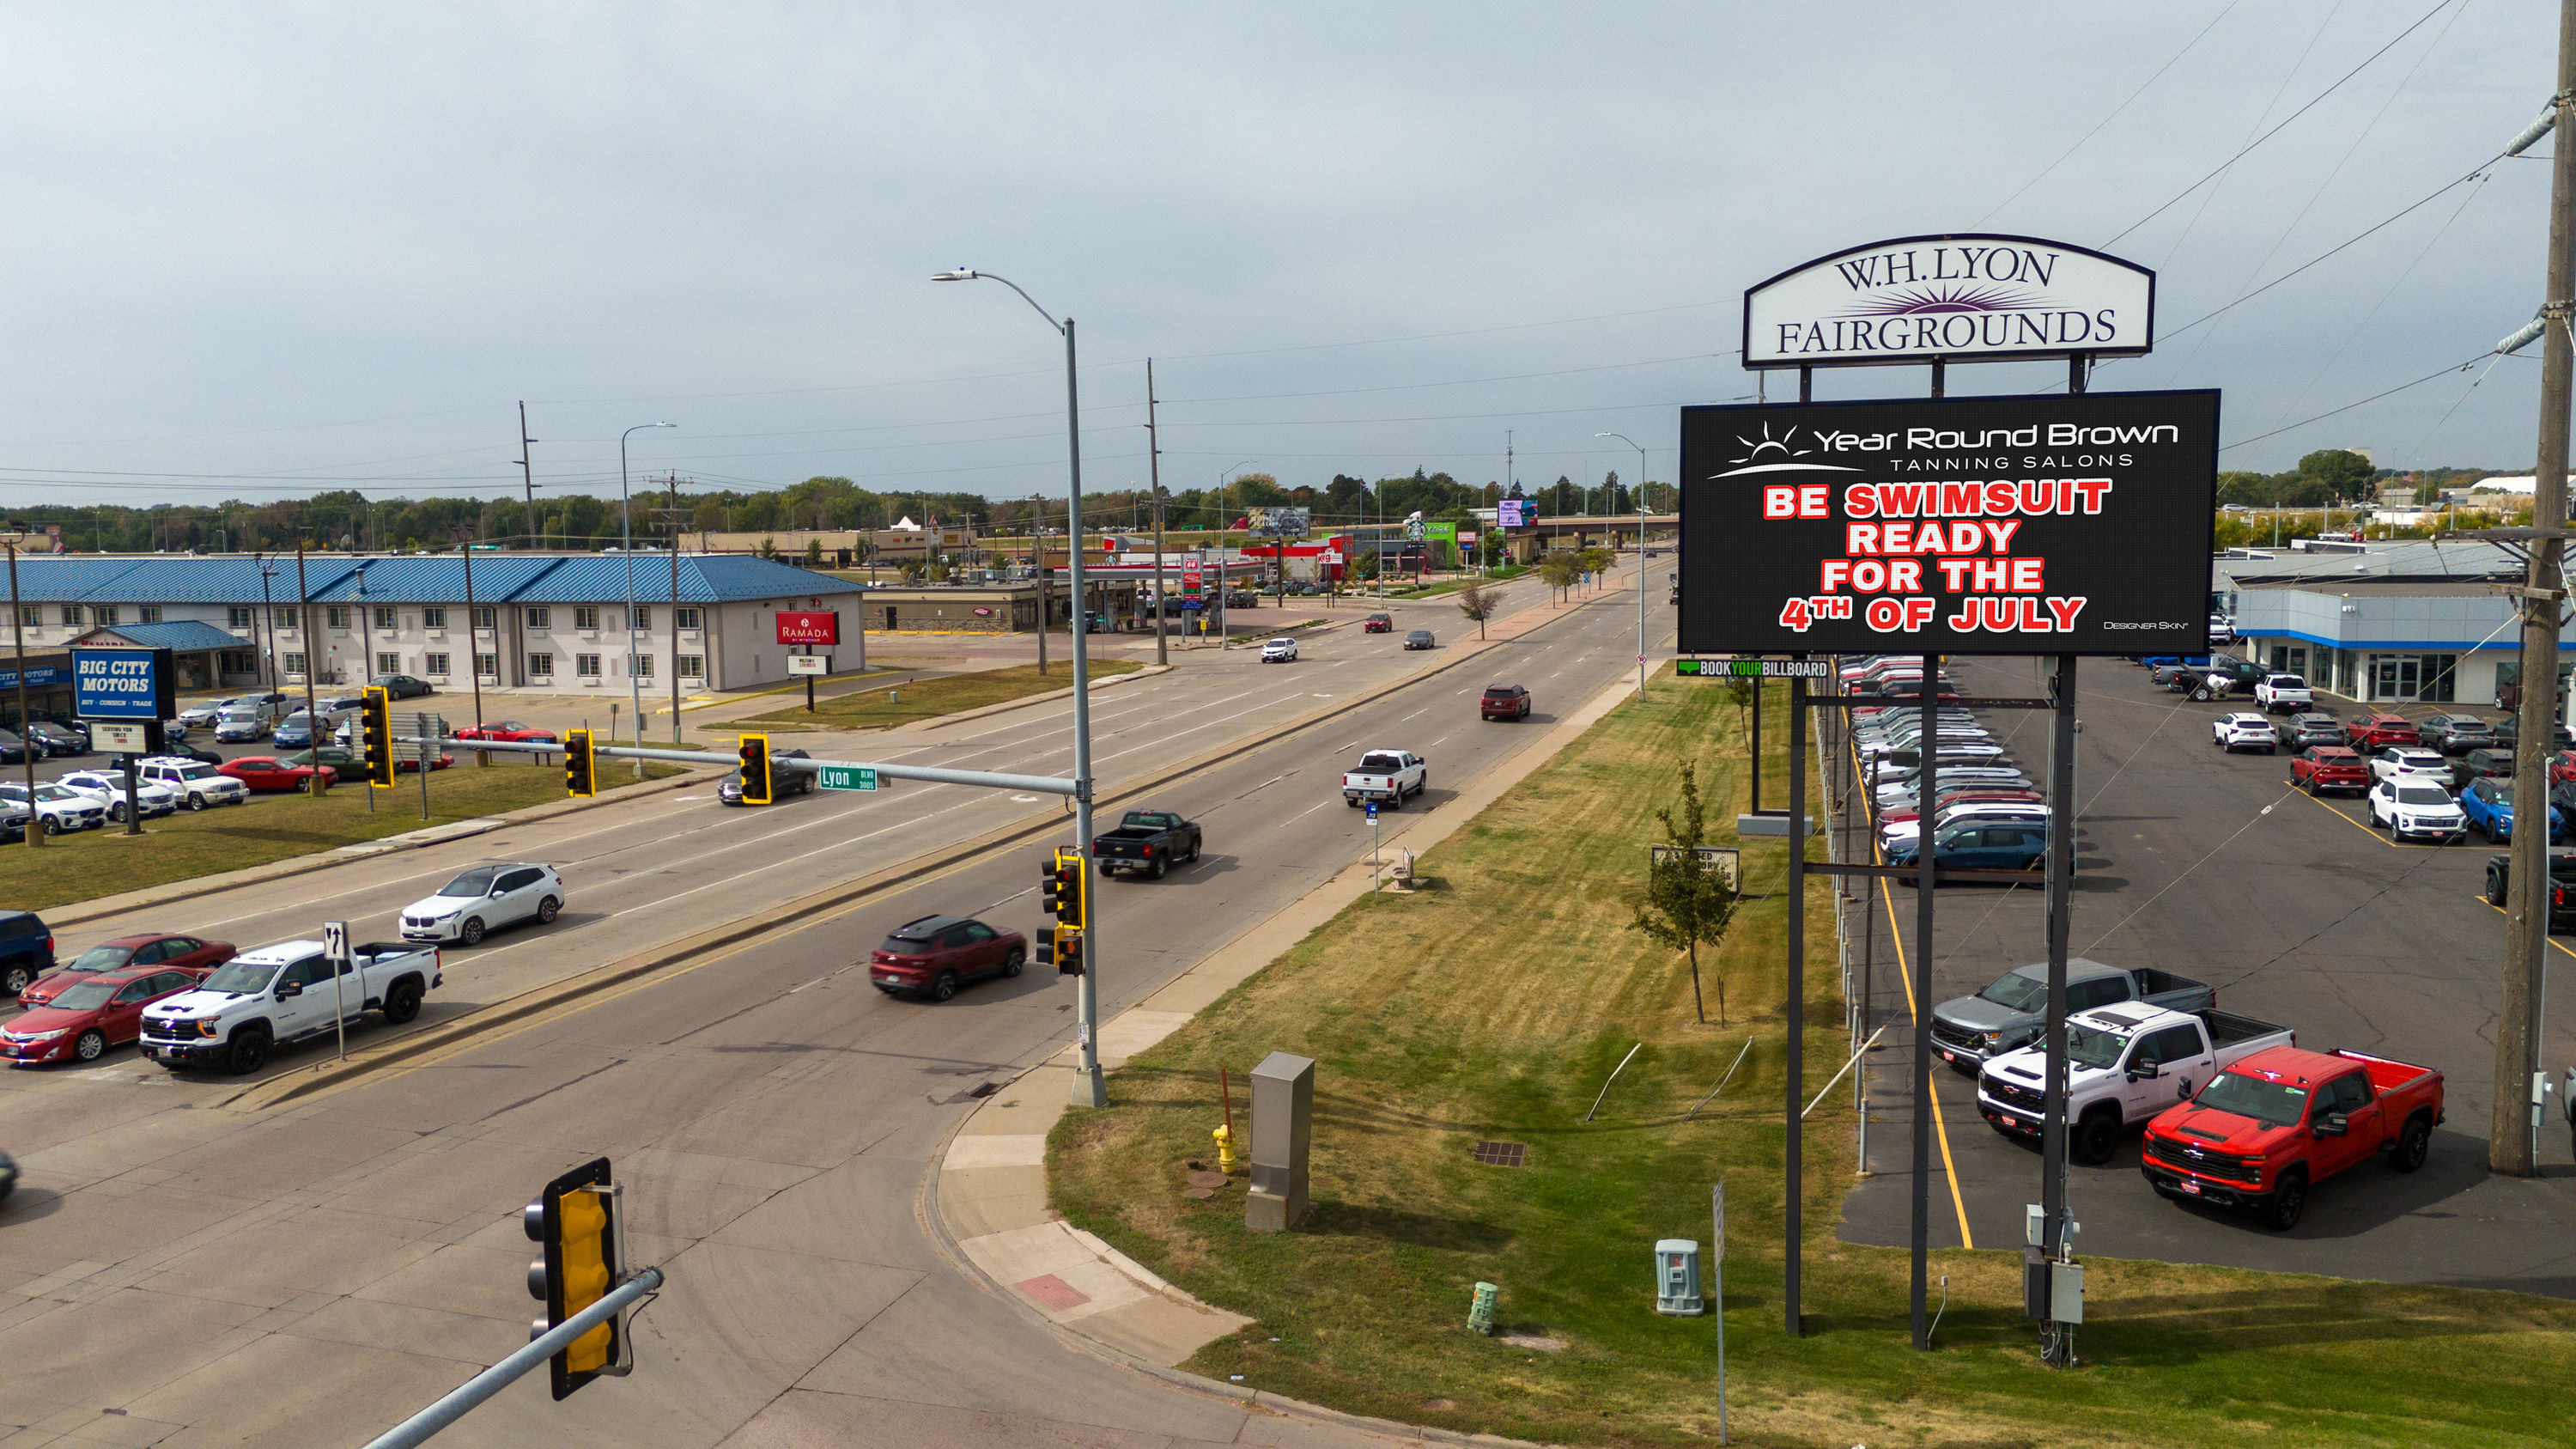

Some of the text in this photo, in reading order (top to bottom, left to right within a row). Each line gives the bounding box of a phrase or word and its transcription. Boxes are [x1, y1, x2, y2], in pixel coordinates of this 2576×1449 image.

[1776, 309, 2116, 353] FAIRGROUNDS
[1814, 423, 2178, 452] Year Round Brown
[1890, 454, 2133, 471] TANNING SALONS
[1763, 478, 2112, 520] BE SWIMSUIT
[1846, 519, 2022, 557] READY
[1820, 557, 2044, 594] FOR THE
[1779, 596, 2087, 633] 4TH OF JULY
[782, 626, 829, 637] RAMADA
[78, 661, 149, 675] BIG CITY
[82, 678, 149, 692] MOTORS
[823, 767, 850, 787] Lyon
